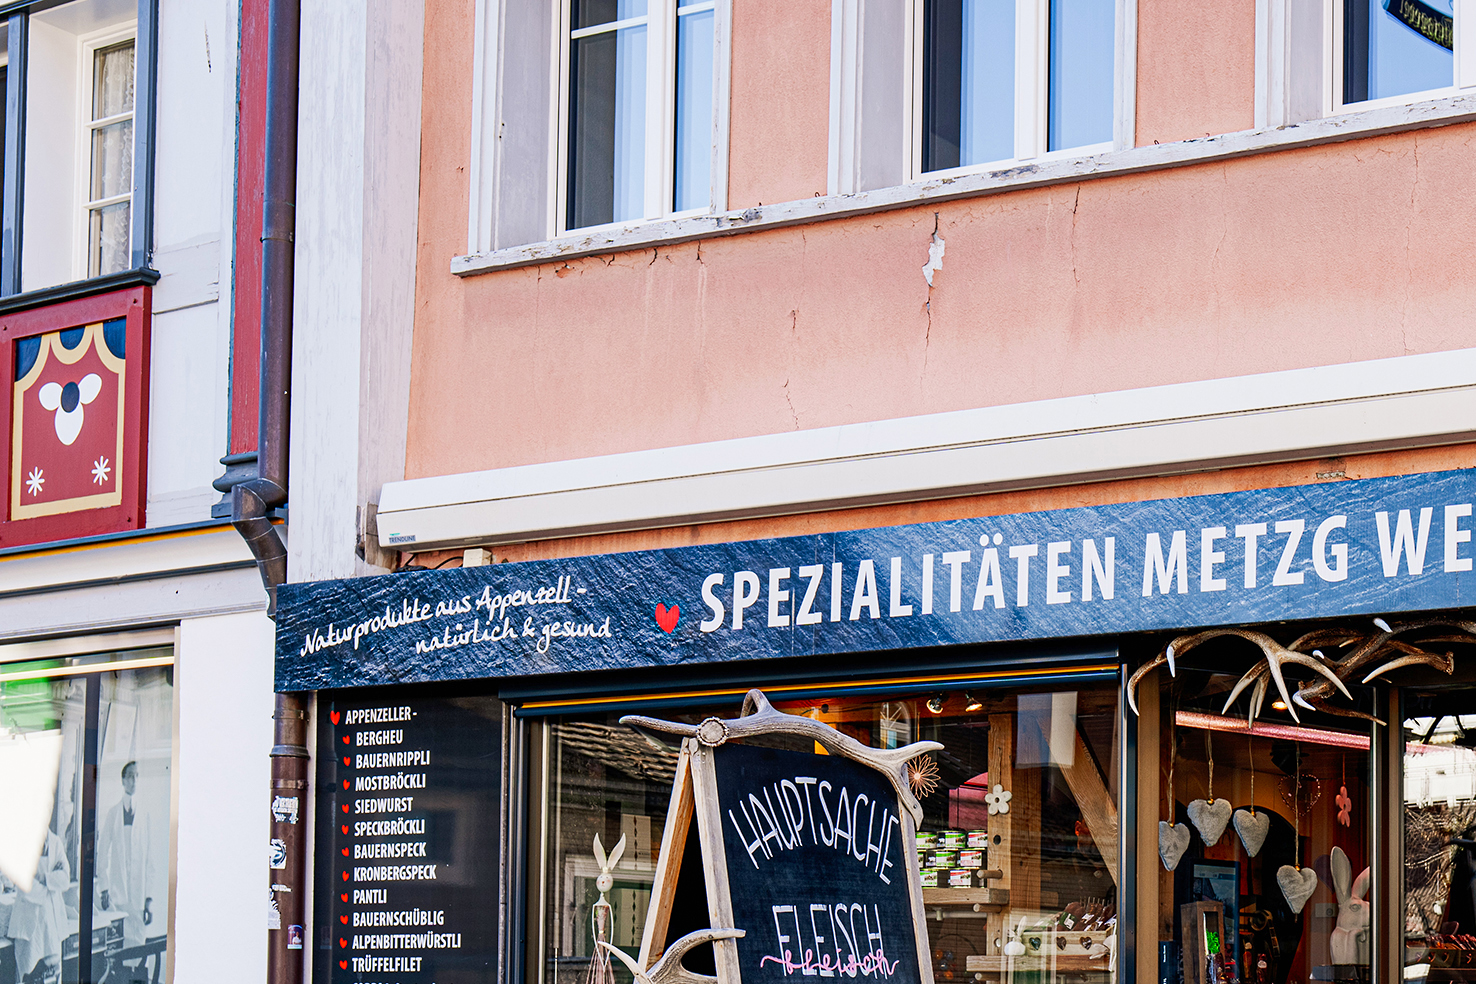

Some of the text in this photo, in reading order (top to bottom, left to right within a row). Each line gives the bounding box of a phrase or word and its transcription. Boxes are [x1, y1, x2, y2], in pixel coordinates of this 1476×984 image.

[699, 532, 1115, 633] SPEZIALITÄTEN
[1142, 515, 1348, 597] METZG
[301, 598, 434, 657] Naturprodukte
[435, 592, 472, 617] aus
[416, 617, 612, 654] natürlich & gesund
[356, 729, 404, 746] BERGHEU
[355, 750, 431, 769] BAUERNRIPPLI
[355, 772, 426, 792] MOSTBRÖCKLI
[354, 797, 414, 814] SIEDWURST
[354, 817, 426, 837] SPECKBRÖCKLI
[728, 776, 899, 885] HAUPTSACHE
[354, 842, 427, 859] BAUERNSPECK
[353, 865, 437, 882] KRONBERGSPECK
[353, 889, 388, 904] PANTLI
[352, 908, 445, 927] BAUERNSCHÜBLIG
[352, 931, 462, 950] ALPENBITTERWÜRSTLI
[772, 903, 888, 980] FLEISCH
[351, 955, 422, 972] TRÜFFELFILET
